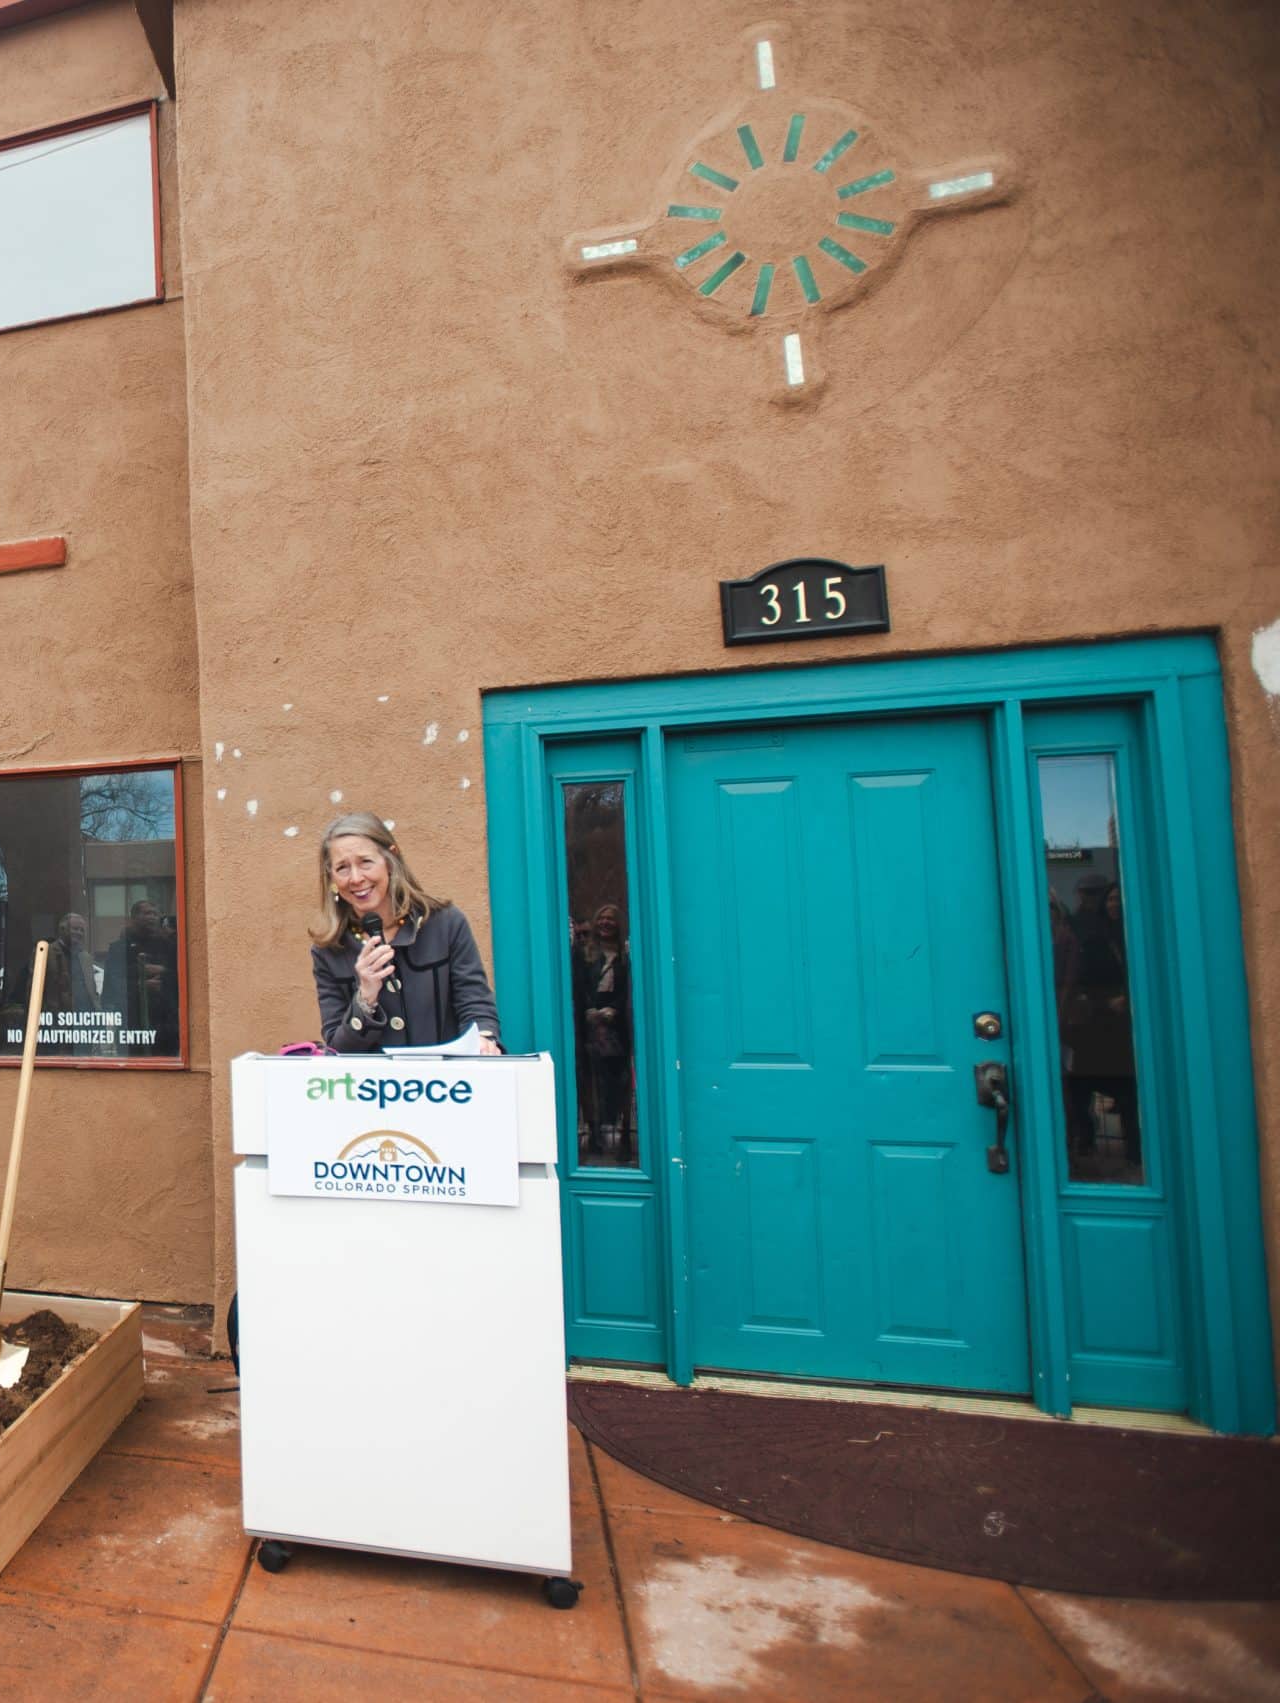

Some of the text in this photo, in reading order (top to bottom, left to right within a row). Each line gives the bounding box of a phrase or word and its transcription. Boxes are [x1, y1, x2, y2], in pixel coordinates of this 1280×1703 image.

[759, 576, 847, 625] 315
[38, 1011, 122, 1027] NO SOLICITING
[7, 1029, 157, 1045] NO NAUTHORIZED ENTRY
[306, 1072, 473, 1109] artspace
[313, 1161, 466, 1185] DOWNTOWN
[314, 1181, 467, 1197] COLORADO SPRINGS
